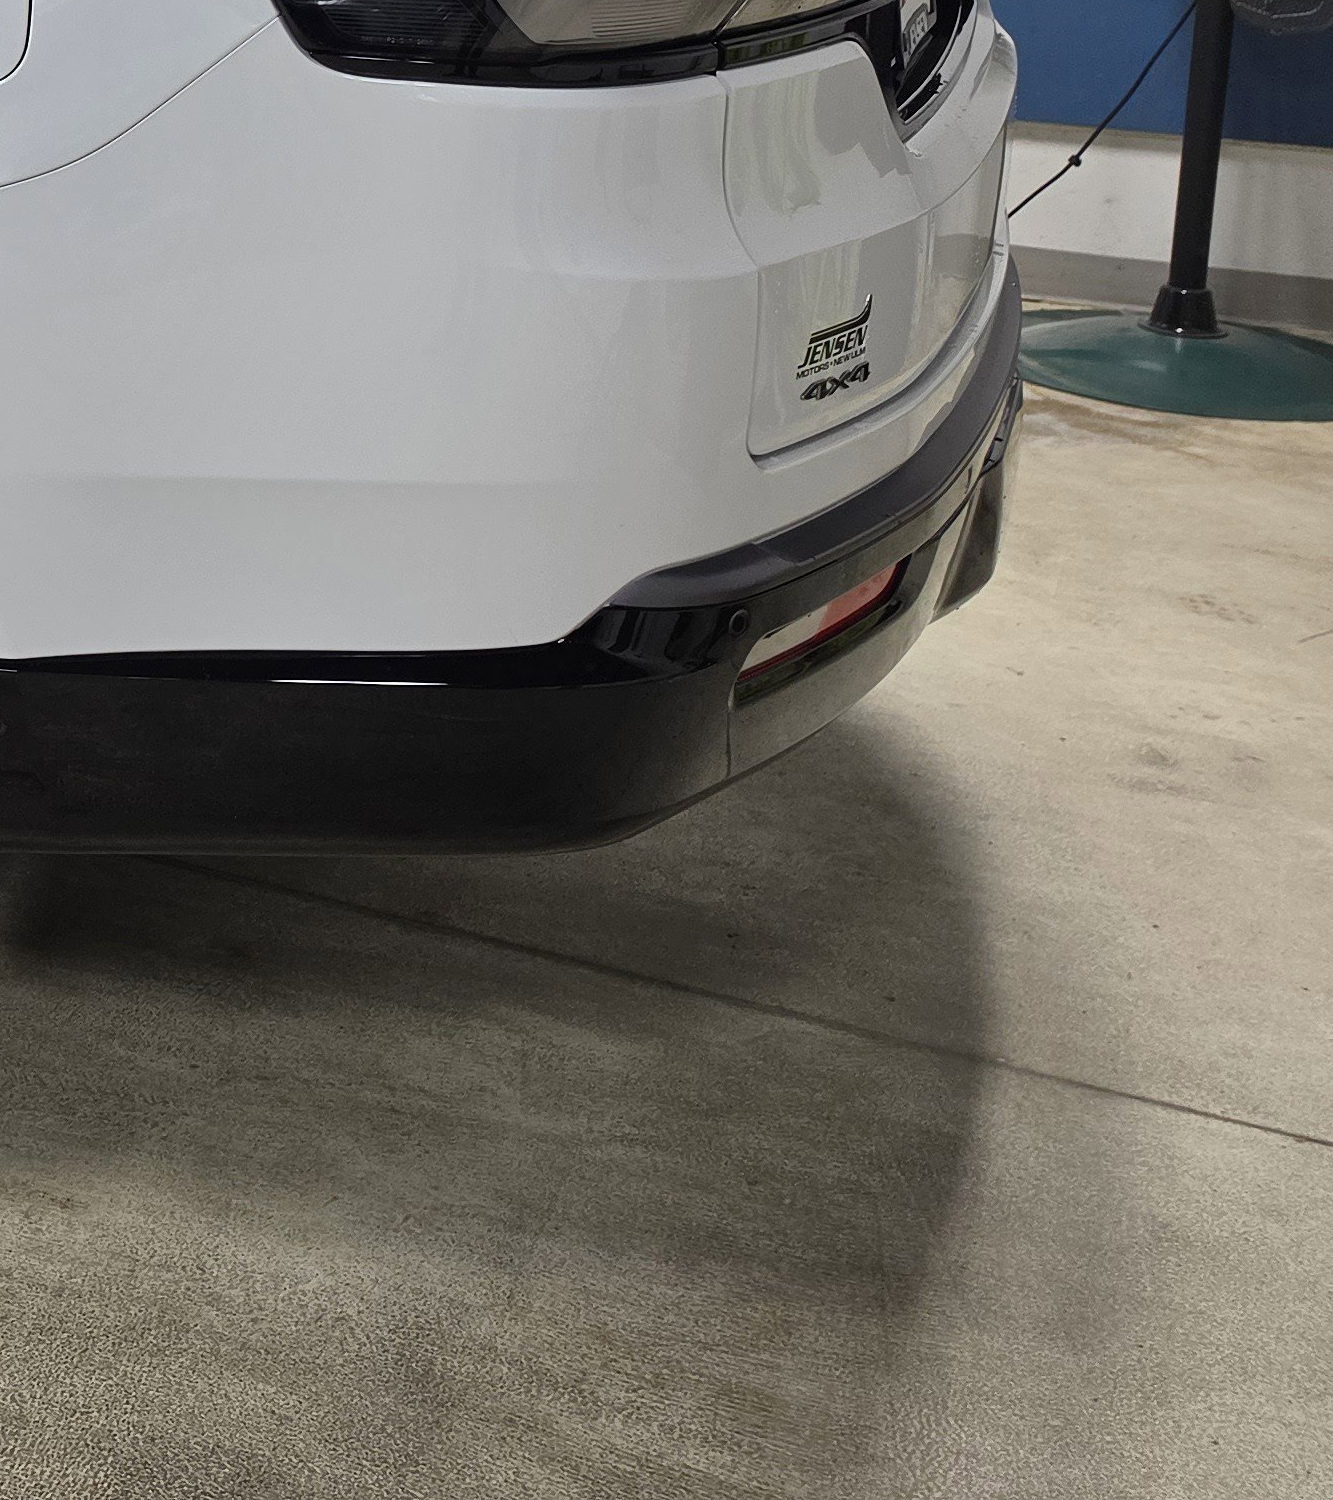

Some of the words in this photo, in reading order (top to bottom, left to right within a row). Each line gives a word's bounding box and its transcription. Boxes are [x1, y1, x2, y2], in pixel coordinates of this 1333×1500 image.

[797, 325, 868, 369] JENSEN
[795, 362, 830, 380] MOTORS
[833, 354, 851, 367] NEW
